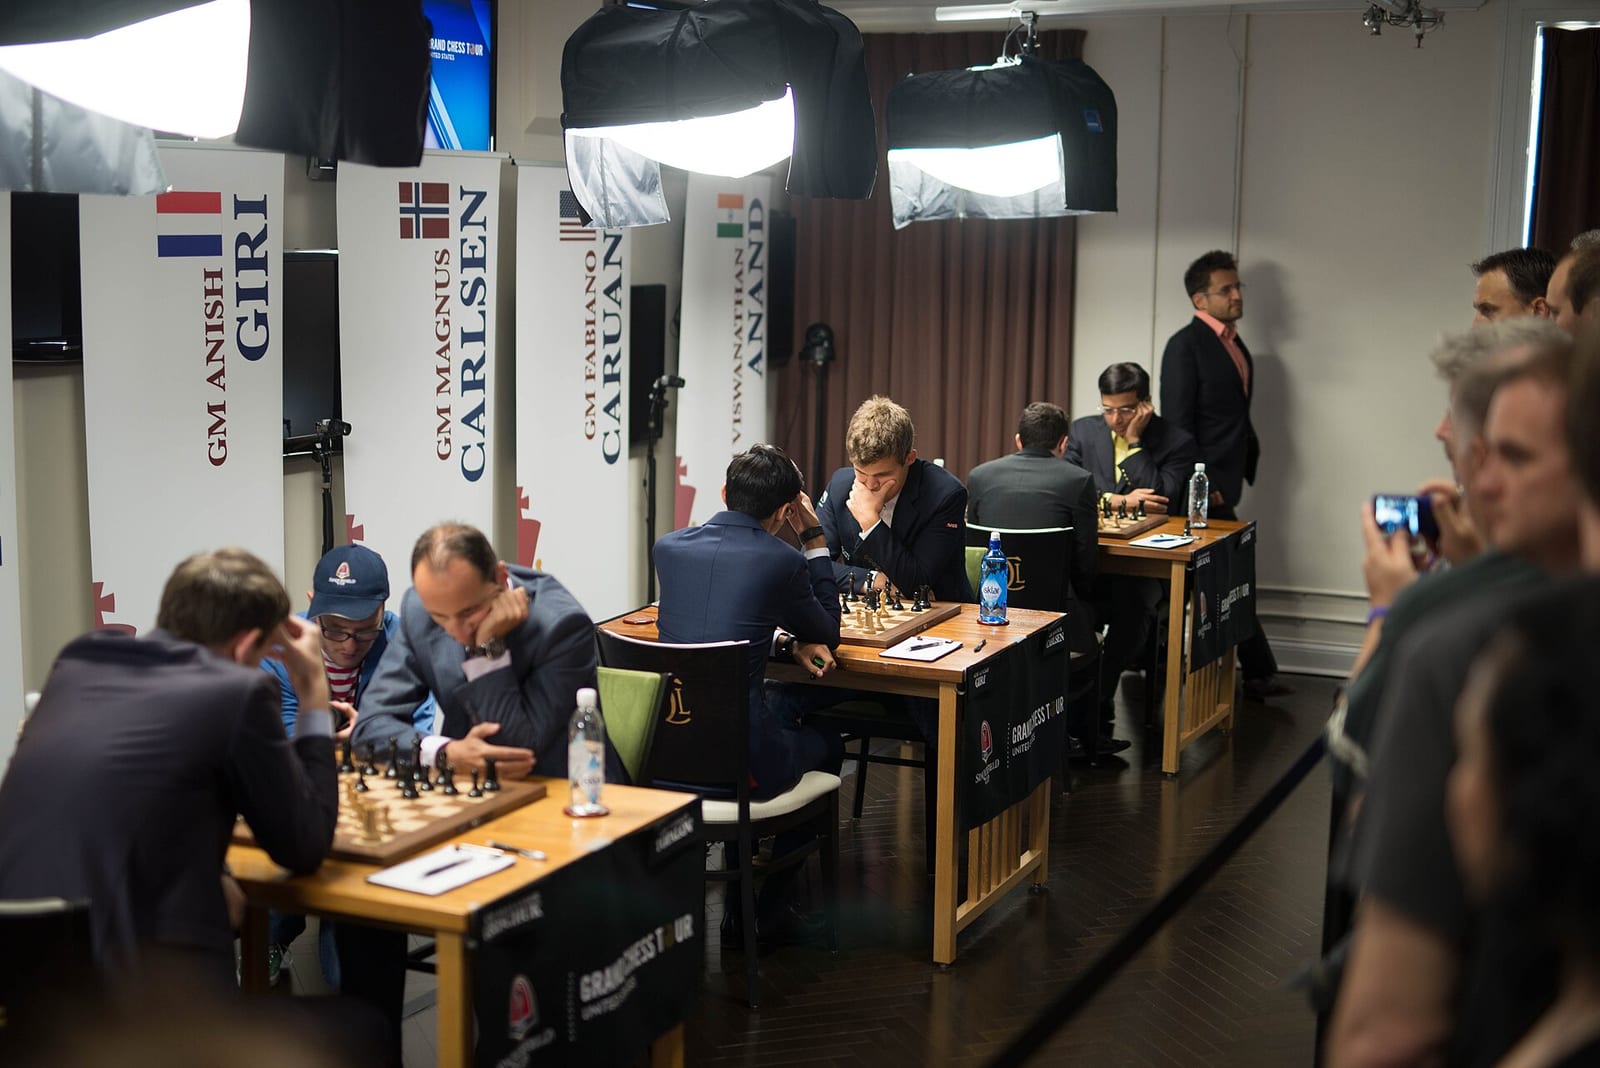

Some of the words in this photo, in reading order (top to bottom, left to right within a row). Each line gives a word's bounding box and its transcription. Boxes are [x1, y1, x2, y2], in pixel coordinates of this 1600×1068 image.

[430, 38, 446, 51] RAND
[447, 40, 465, 54] CHESS
[466, 42, 484, 56] TOUR
[203, 266, 226, 393] ANISH
[233, 193, 270, 362] GIRI
[433, 248, 452, 397] MAGNUS
[459, 184, 488, 483] CARLSEN
[584, 249, 597, 381] FABIANO
[602, 227, 624, 466] CARUAN
[732, 247, 745, 445] VISWANATHAN
[747, 198, 764, 378] ANAND
[205, 399, 228, 467] GM
[435, 403, 452, 461] GM
[584, 391, 597, 441] GM
